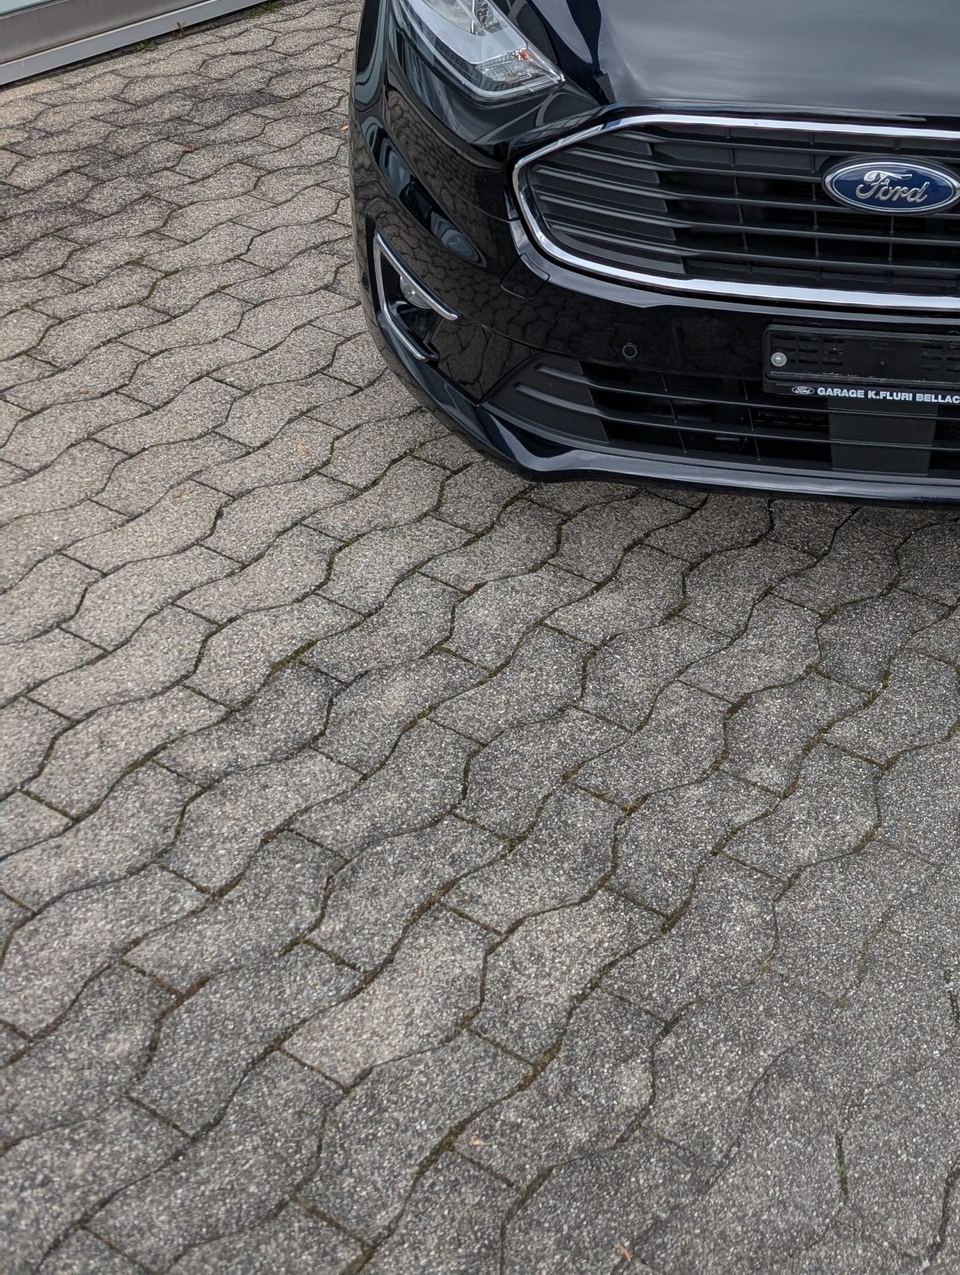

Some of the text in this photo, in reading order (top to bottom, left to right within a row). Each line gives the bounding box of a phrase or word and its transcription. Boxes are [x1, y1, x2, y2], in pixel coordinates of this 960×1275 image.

[855, 170, 928, 203] Ford
[817, 387, 864, 398] GARAGE
[868, 390, 912, 401] K.FLURI
